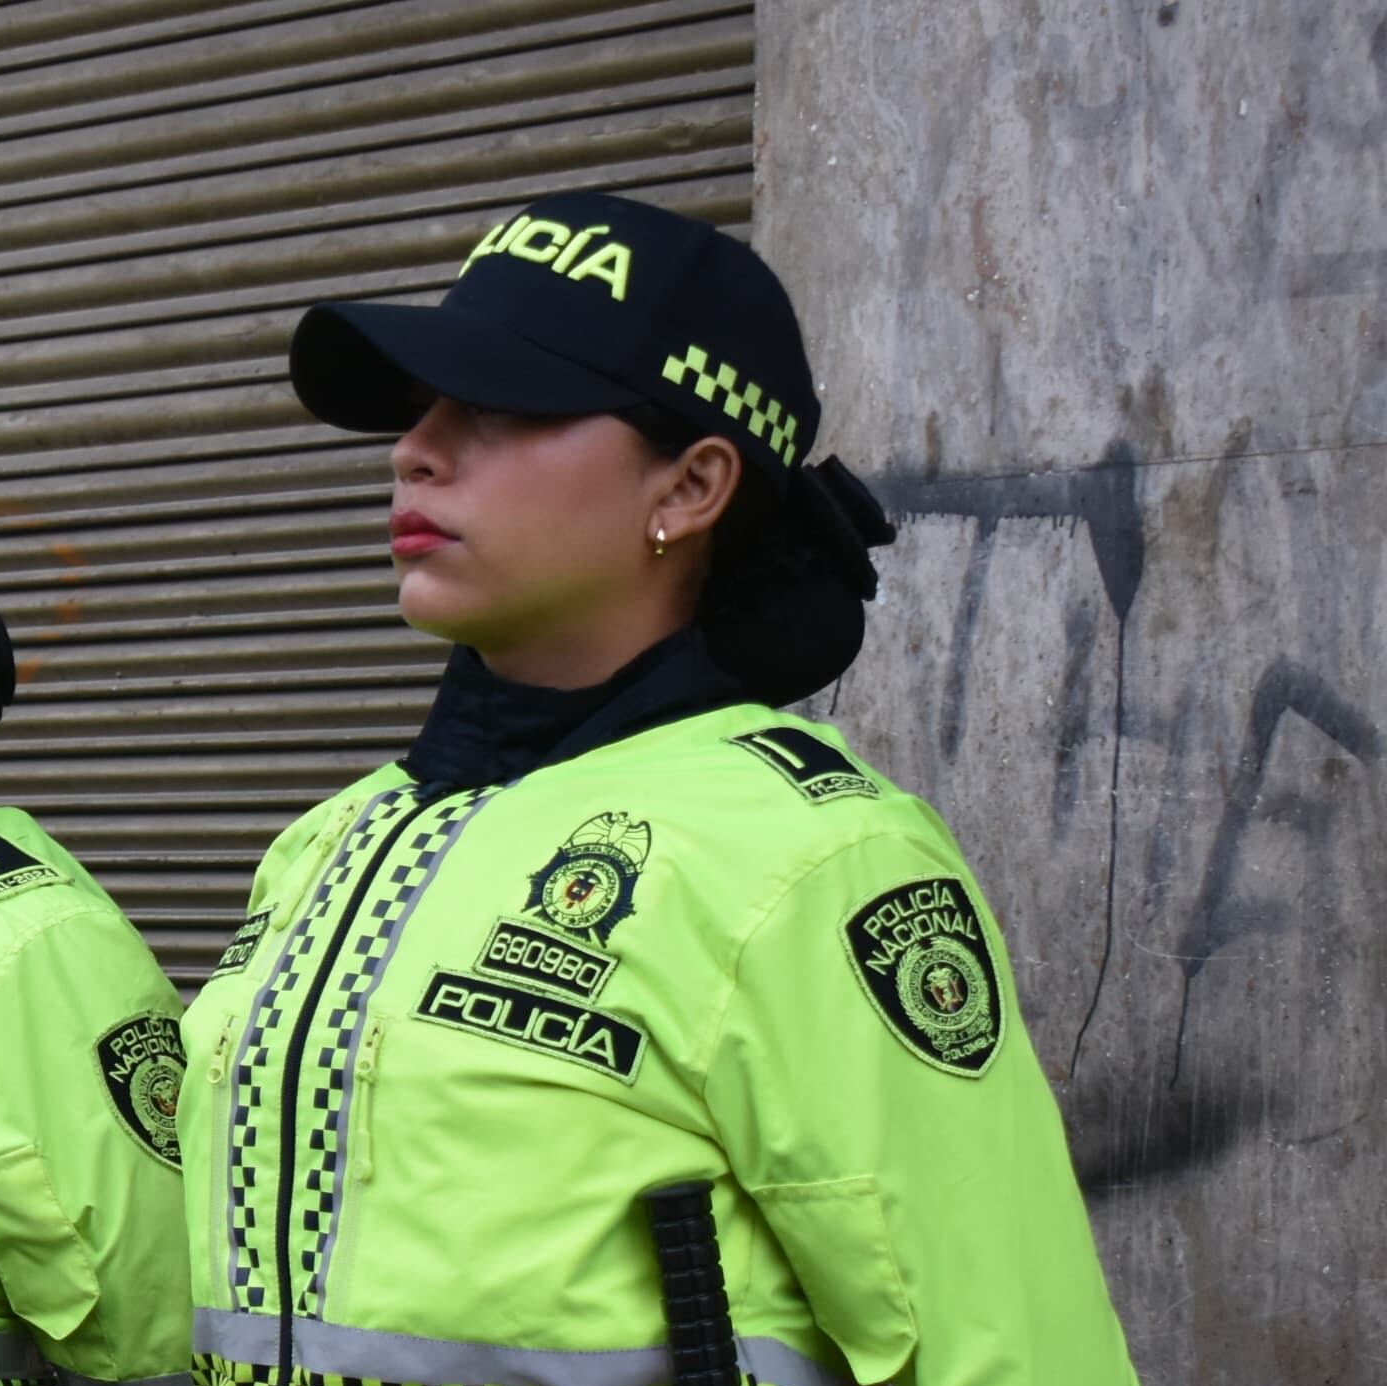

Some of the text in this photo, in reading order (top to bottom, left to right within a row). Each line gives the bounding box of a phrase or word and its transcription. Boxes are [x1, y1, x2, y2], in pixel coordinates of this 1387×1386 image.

[459, 215, 631, 301] LICÍA
[863, 881, 957, 940] POLICÍA
[488, 932, 602, 989] 680980
[865, 911, 978, 976] NACIONAL
[429, 983, 617, 1069] POLICÍA
